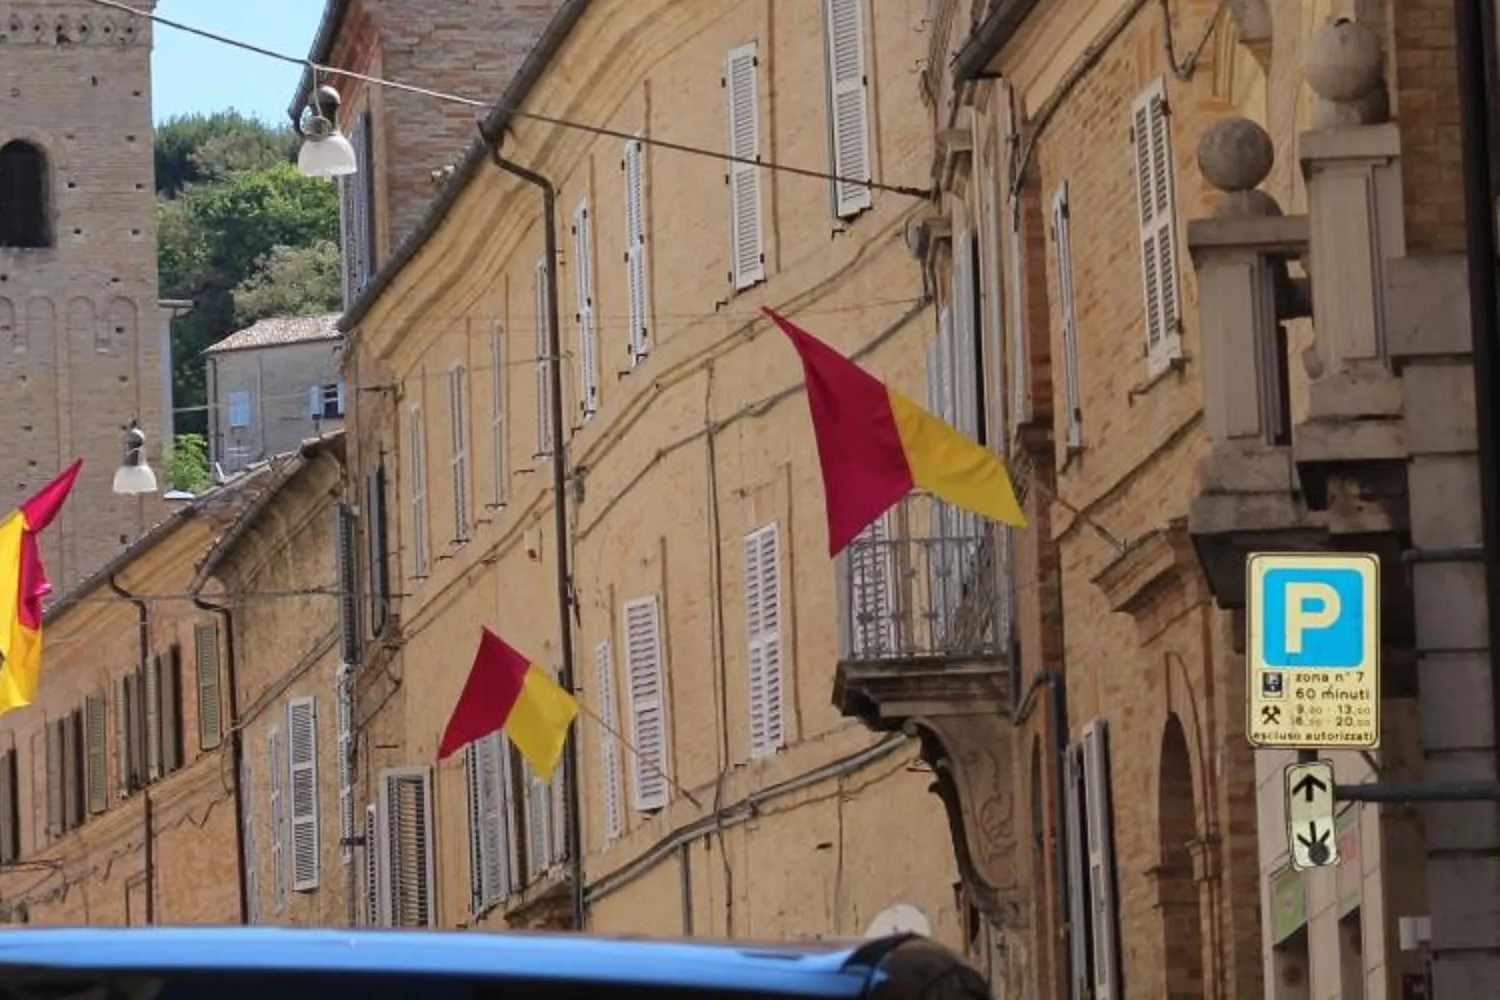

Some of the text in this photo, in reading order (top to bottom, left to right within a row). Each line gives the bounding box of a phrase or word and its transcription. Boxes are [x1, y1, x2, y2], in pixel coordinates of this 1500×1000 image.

[1285, 582, 1341, 653] P
[1295, 672, 1329, 683] zona
[1356, 671, 1365, 683] 7
[1295, 687, 1370, 700] 60 minuti
[1305, 731, 1373, 741] autorizzati
